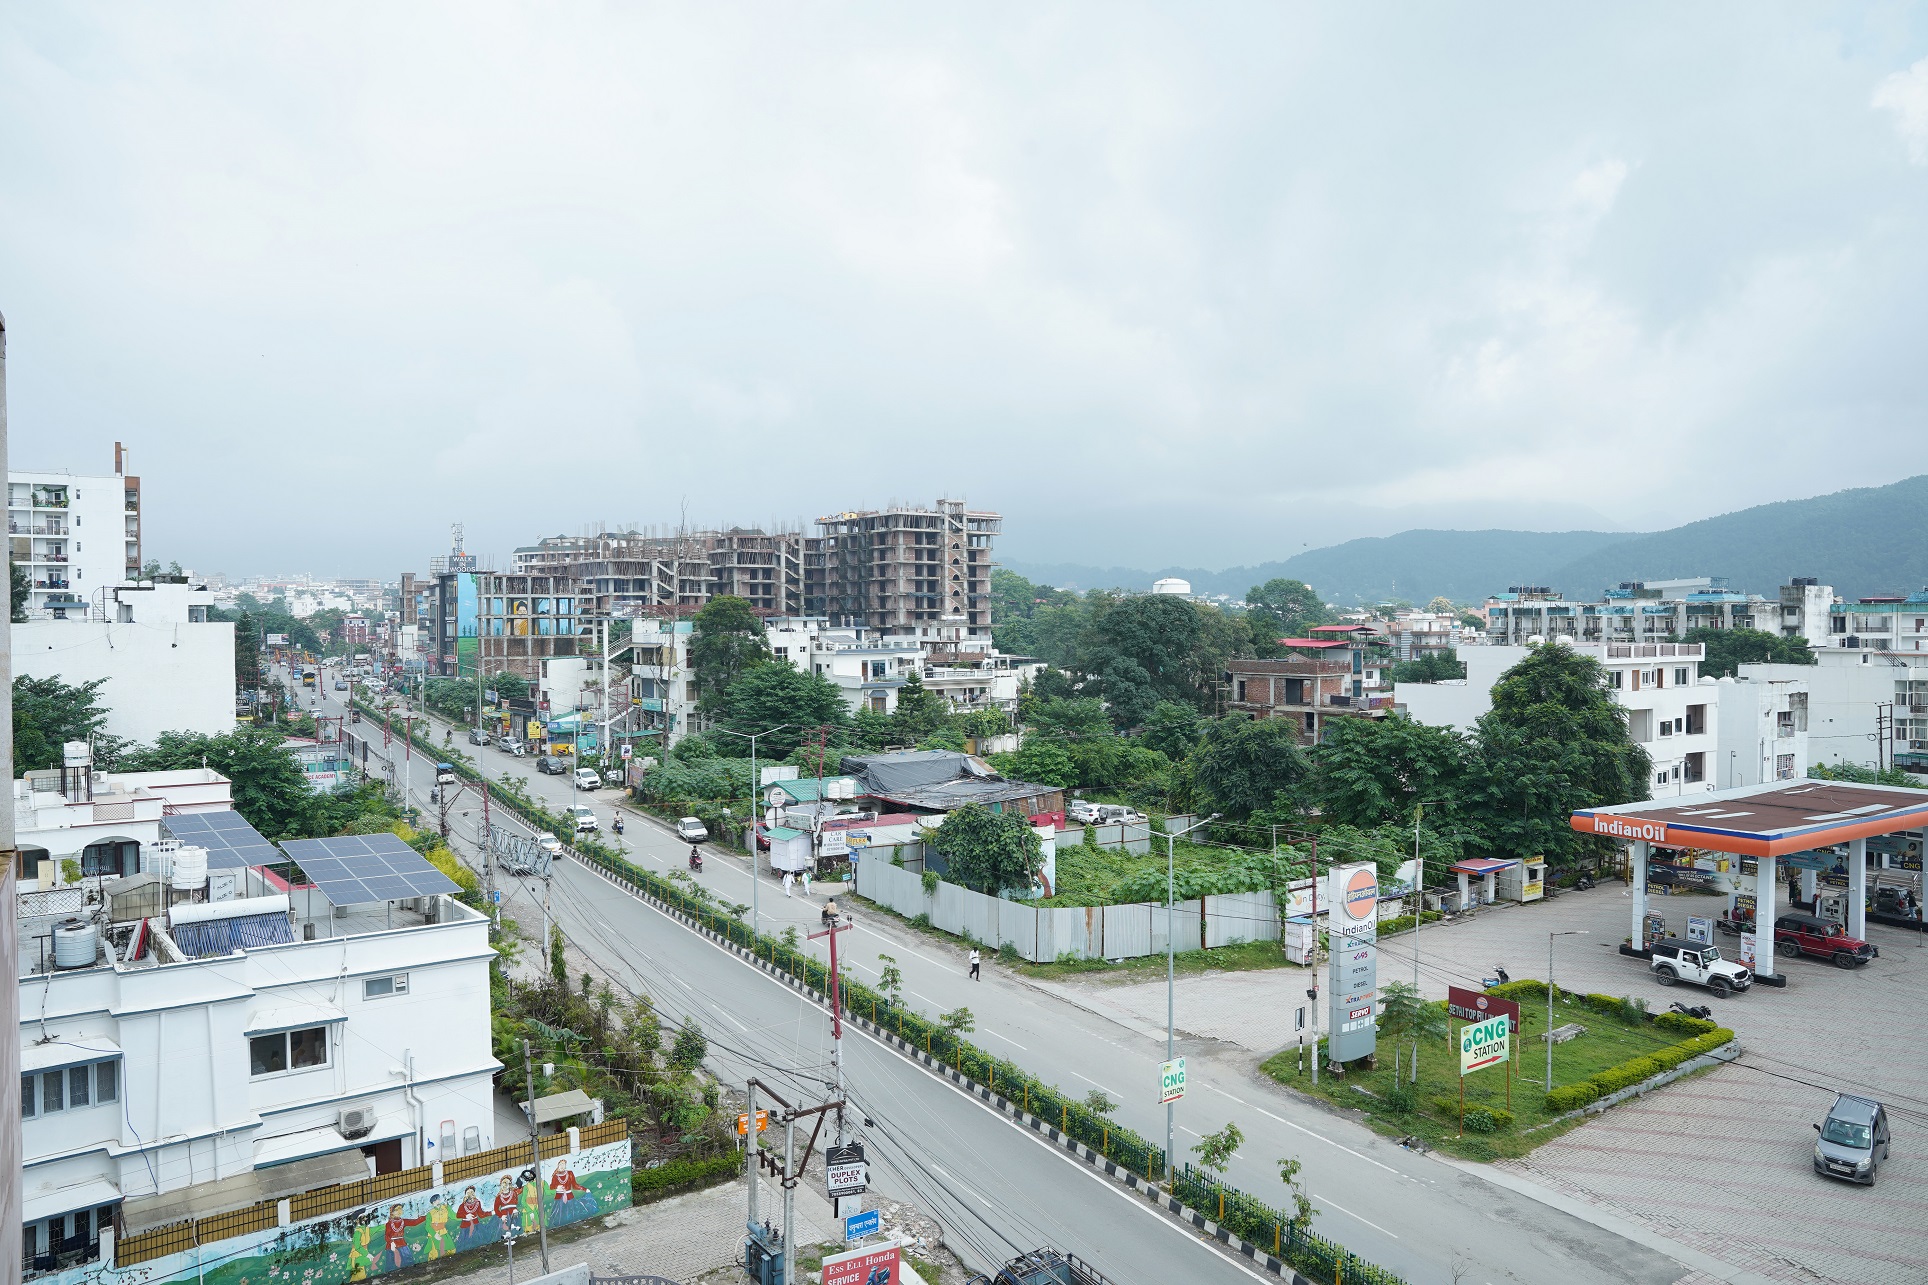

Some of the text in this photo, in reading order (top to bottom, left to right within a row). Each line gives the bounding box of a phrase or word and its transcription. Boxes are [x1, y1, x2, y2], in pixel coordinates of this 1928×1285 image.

[1594, 817, 1665, 841] IndianOil
[1903, 862, 1921, 870] CNG
[1737, 897, 1756, 905] PETROL
[1737, 902, 1756, 910] DIESEL
[1342, 919, 1376, 935] IndianOil
[1352, 965, 1369, 974] PETROL
[1353, 980, 1368, 989] DIESEL
[1350, 1007, 1370, 1019] SERVO
[1465, 1008, 1477, 1020] TOP
[1472, 1020, 1506, 1046] CNG
[1473, 1040, 1505, 1059] STATION
[1163, 1071, 1185, 1088] CNG
[1164, 1086, 1185, 1097] STATION
[831, 1169, 861, 1178] DUPLEX
[834, 1176, 859, 1184] PLOTS
[865, 1252, 895, 1266] Honda
[828, 1272, 860, 1285] SERVICE
